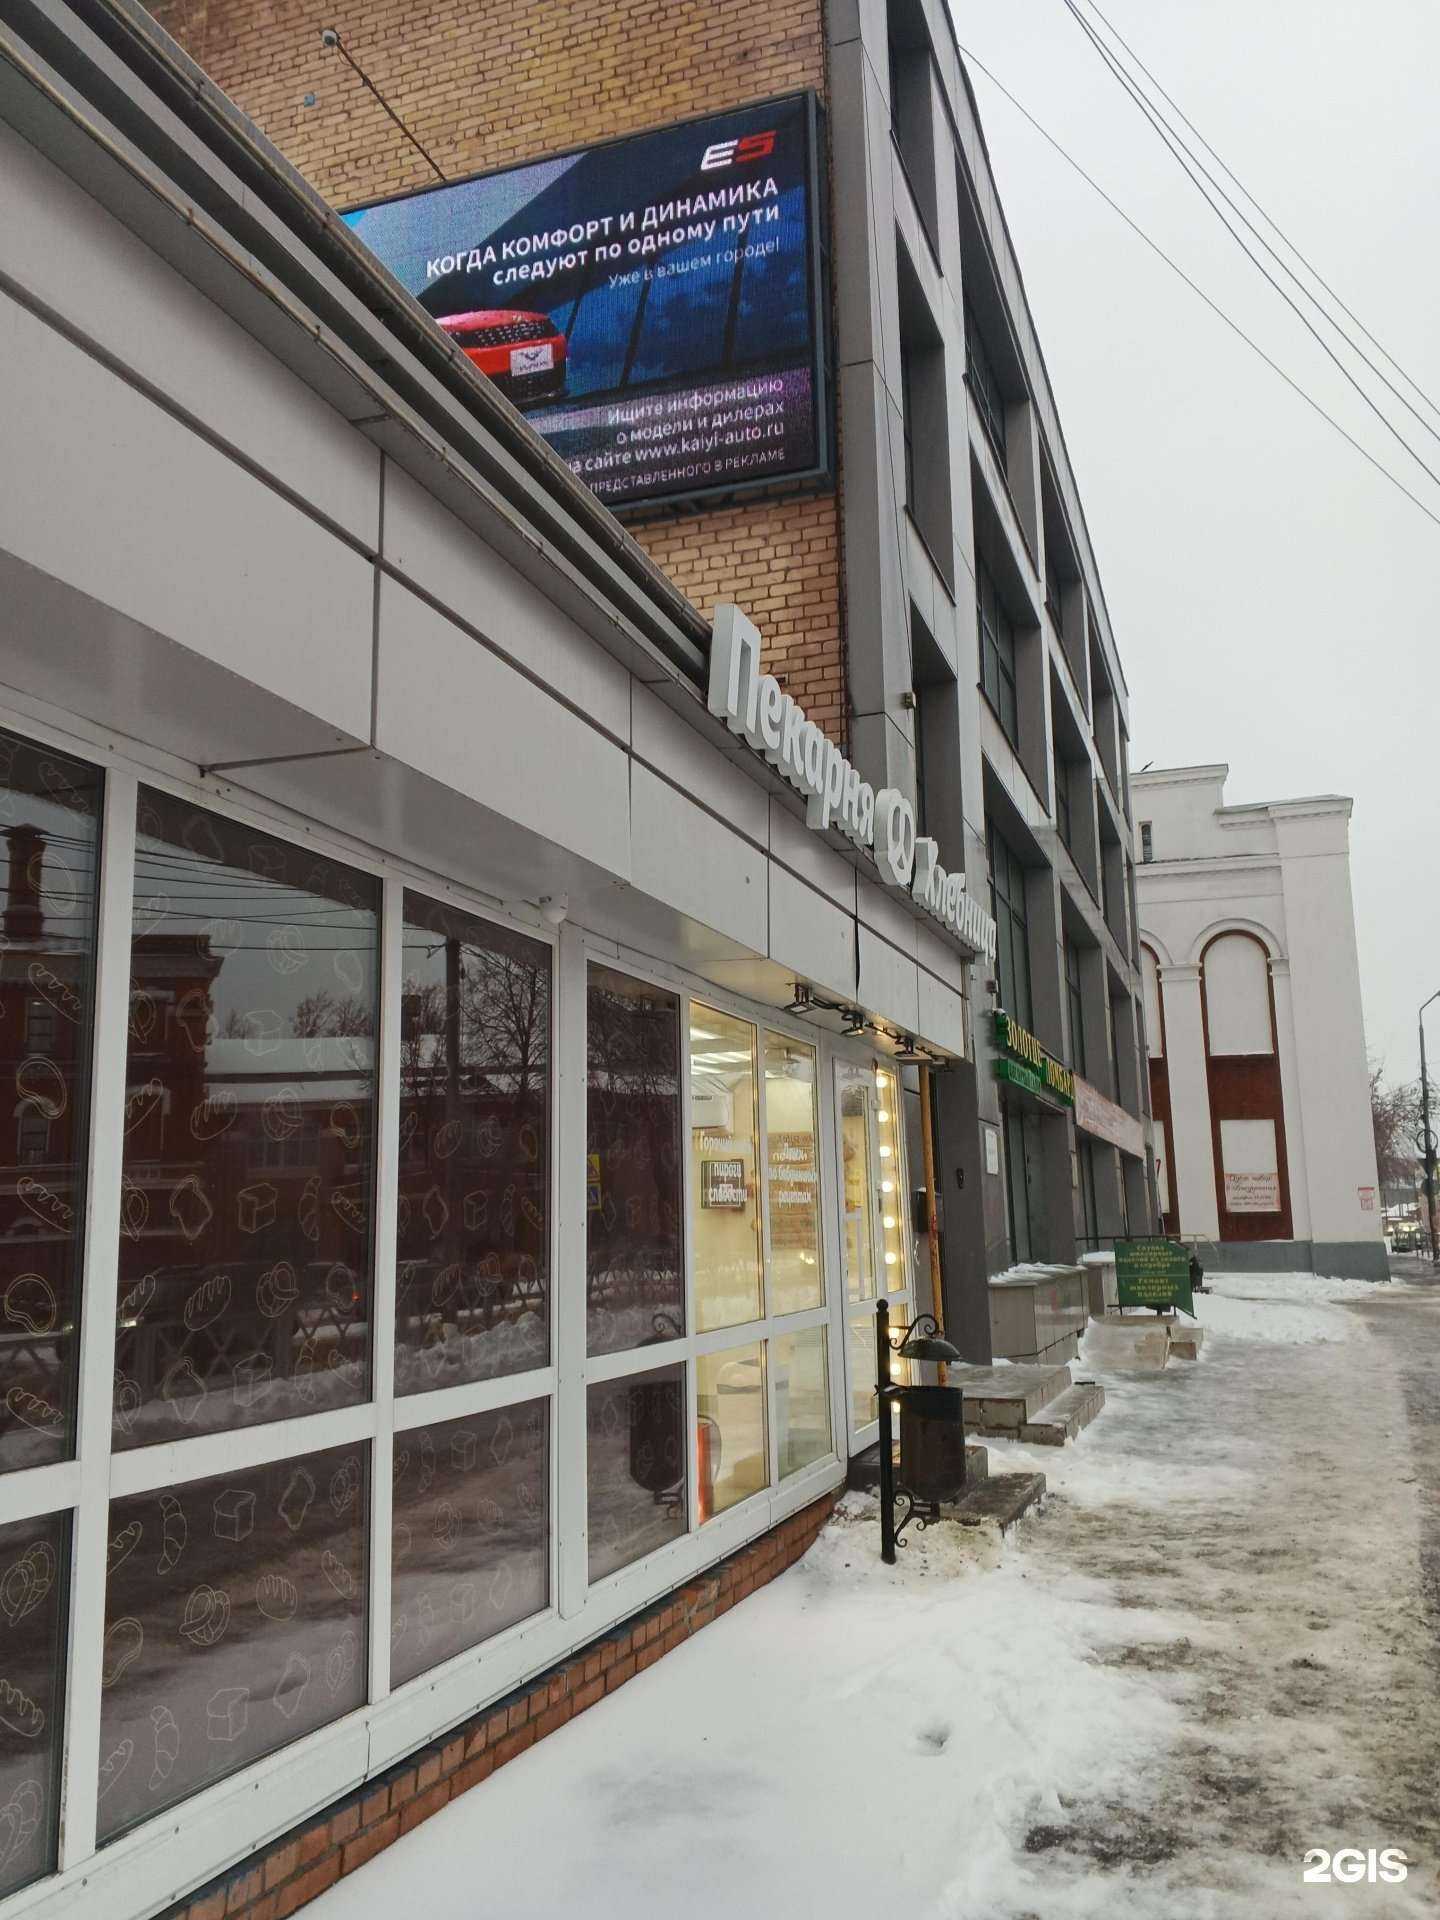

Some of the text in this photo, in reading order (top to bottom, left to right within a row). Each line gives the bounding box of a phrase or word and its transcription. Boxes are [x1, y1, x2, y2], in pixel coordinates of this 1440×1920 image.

[426, 177, 779, 279] КОГДА КОМФОРТ И ДИНАМИКА
[493, 204, 780, 286] следуют по одному пути
[608, 268, 641, 288] Уже
[657, 256, 711, 278] вашем
[608, 379, 783, 425] Ищите информацию
[616, 400, 784, 445] о модели и дилерах
[584, 450, 632, 472] сайте
[635, 421, 784, 462] www.kaiyi-auto.ru
[725, 448, 785, 470] РЕКЛАМЕ
[708, 603, 997, 966] Пекарня Хлебница
